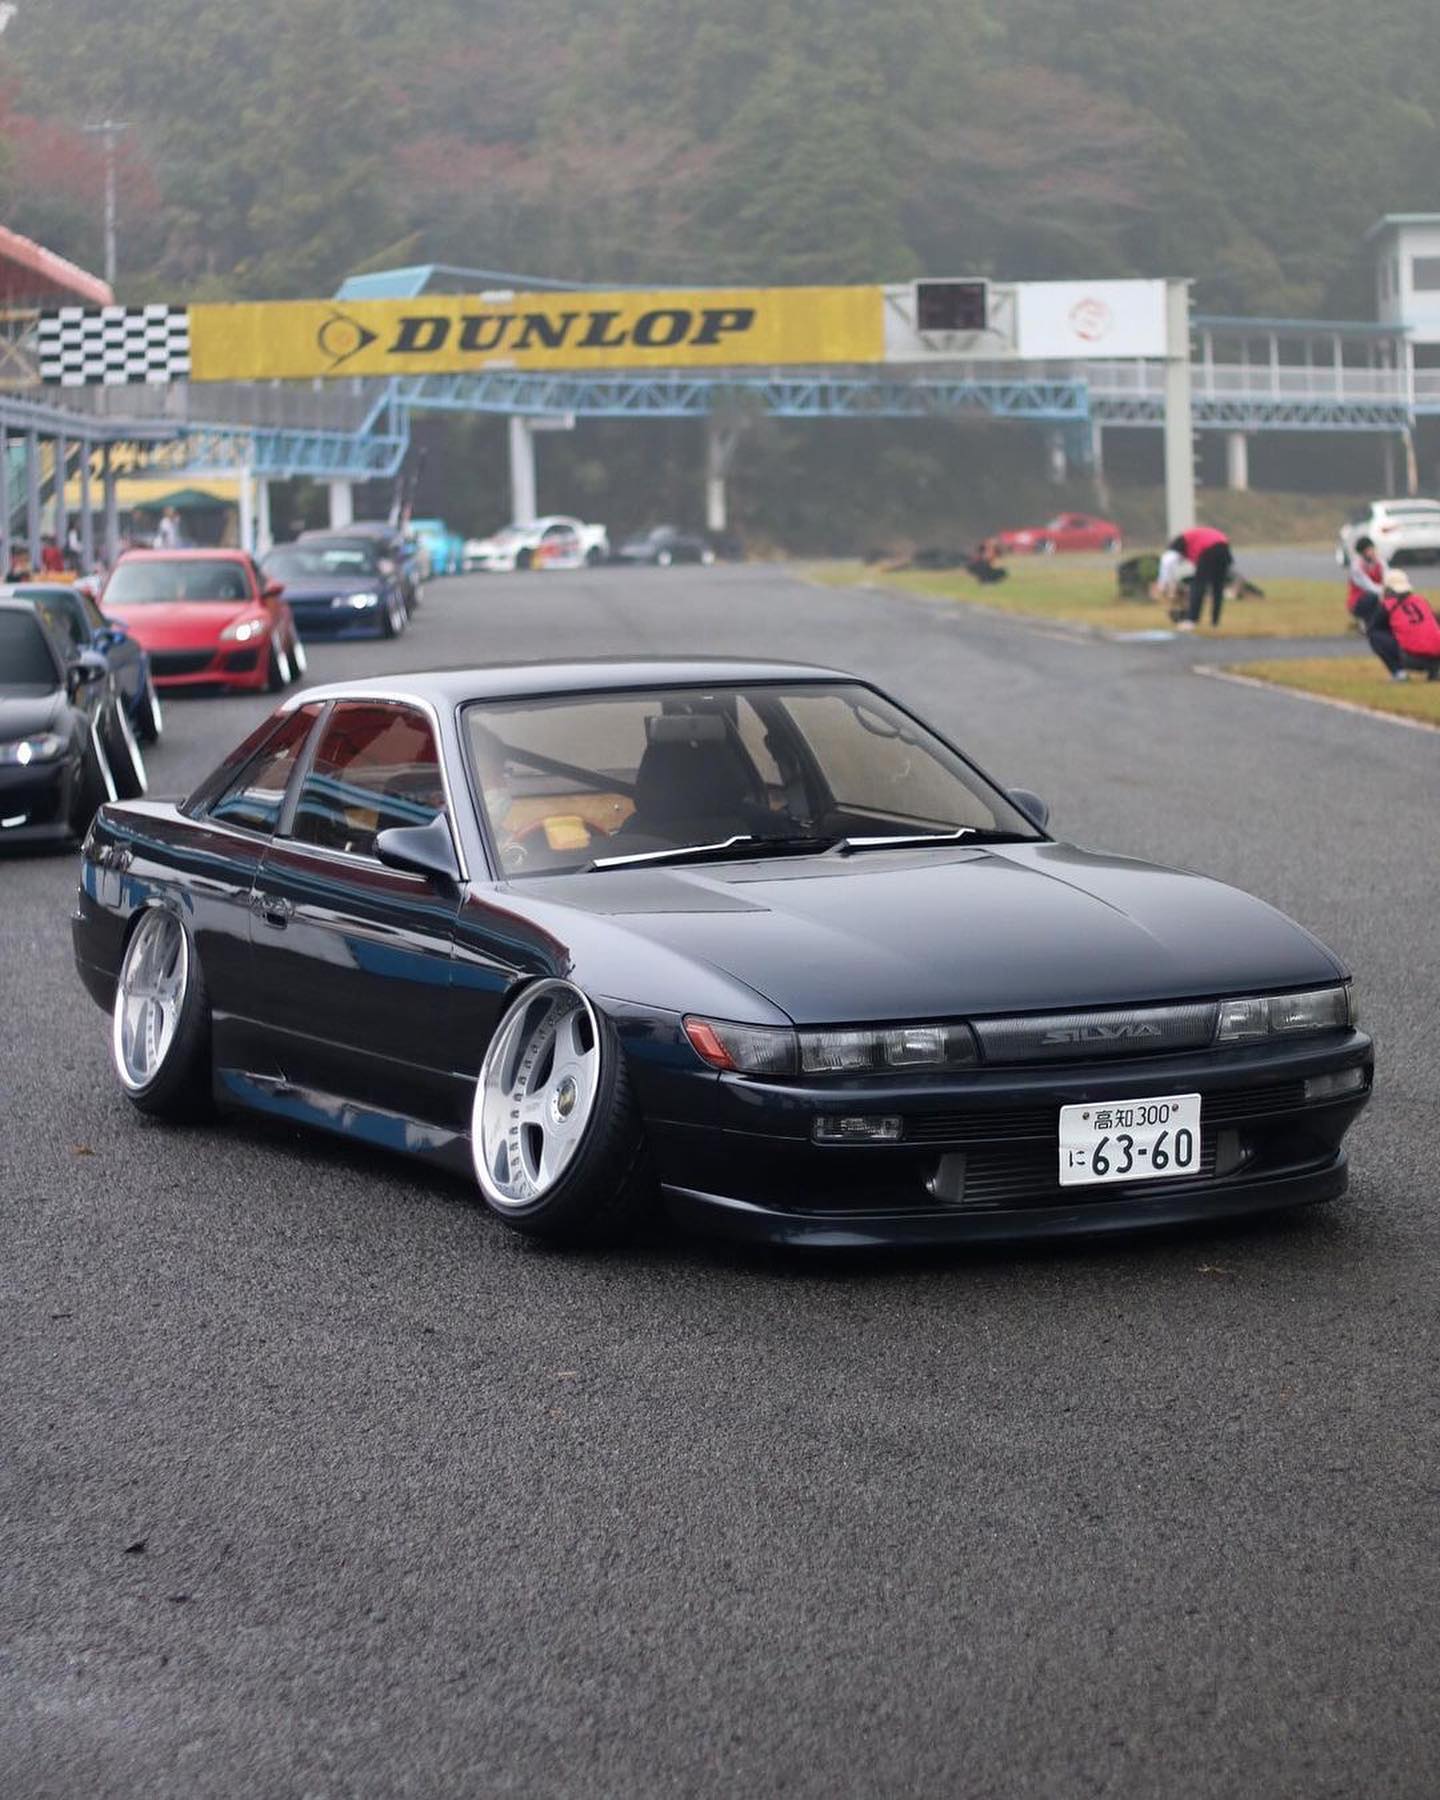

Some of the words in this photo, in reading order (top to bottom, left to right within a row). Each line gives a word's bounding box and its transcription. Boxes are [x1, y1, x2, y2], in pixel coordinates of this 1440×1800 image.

[387, 307, 757, 354] DUNLOP
[1402, 602, 1424, 625] 9
[1041, 1023, 1161, 1045] SILVIA
[1069, 1150, 1086, 1167] に
[1092, 1128, 1193, 1176] 63-60
